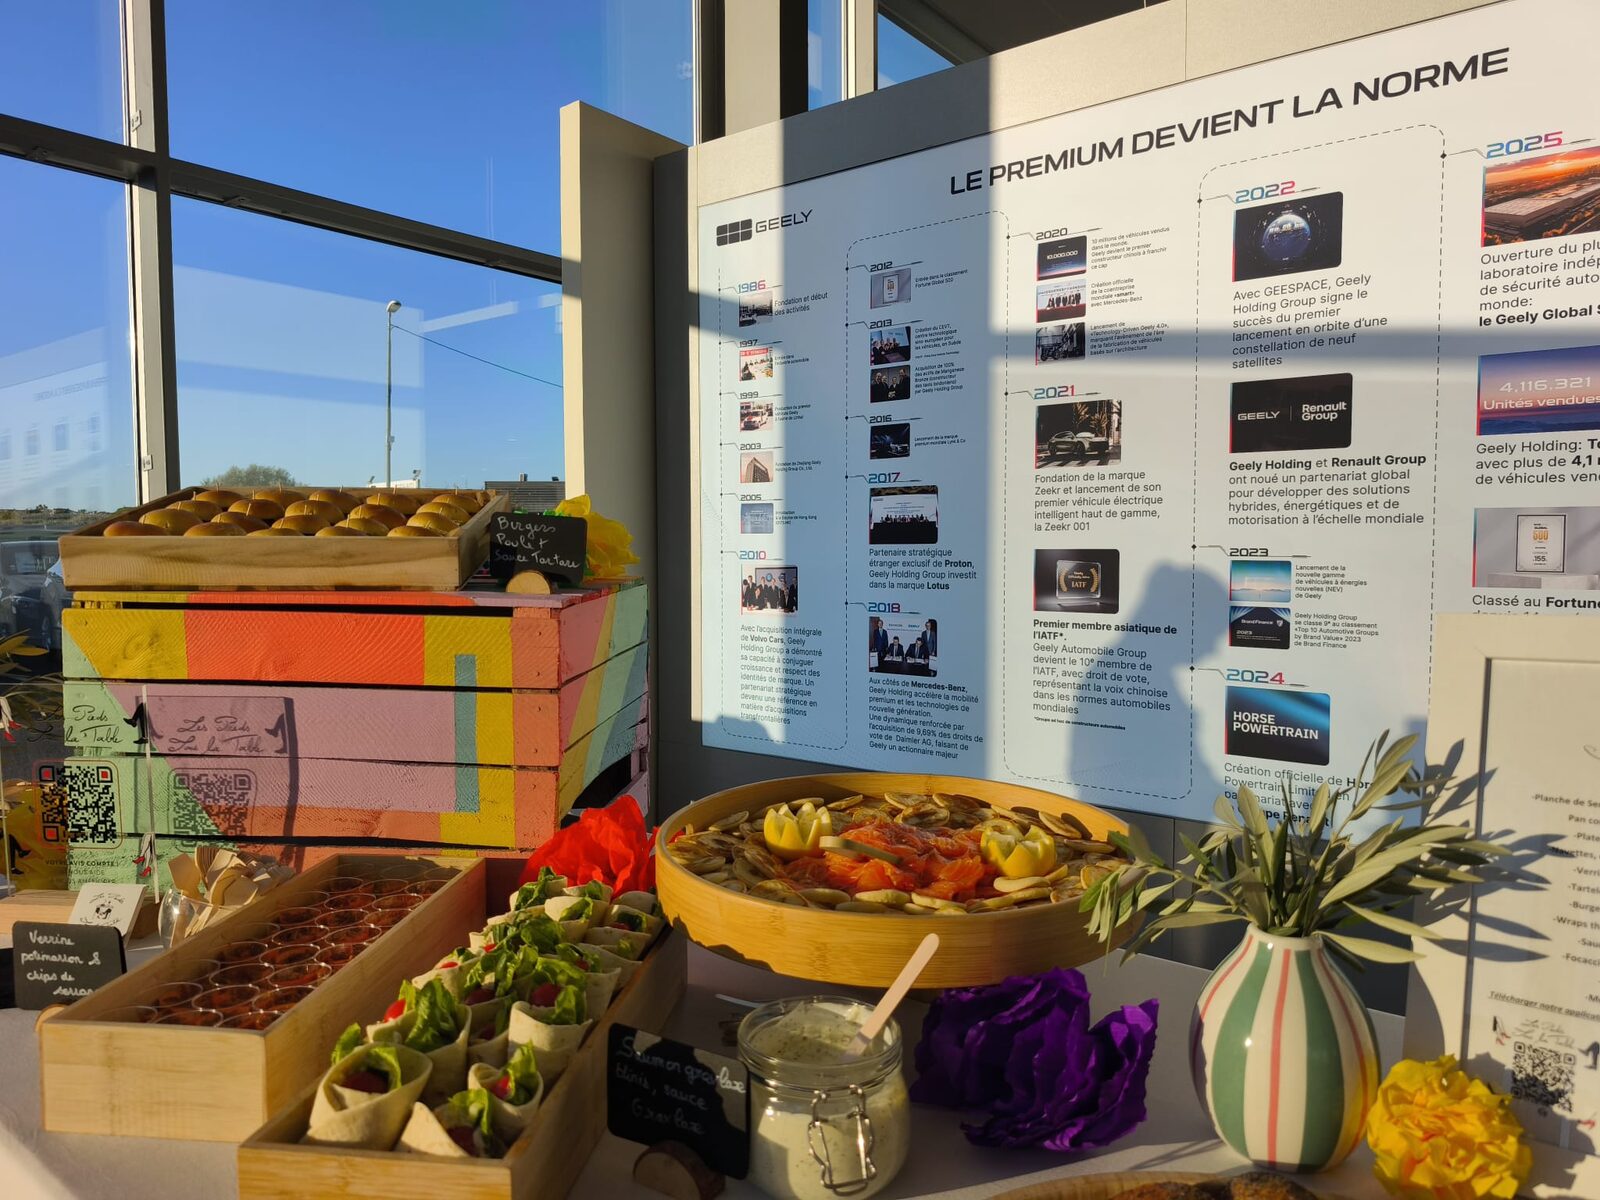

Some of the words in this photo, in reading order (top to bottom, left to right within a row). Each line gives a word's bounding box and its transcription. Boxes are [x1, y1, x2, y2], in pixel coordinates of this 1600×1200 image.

[951, 169, 983, 195] LE
[989, 137, 1125, 187] PREMIUM
[1131, 99, 1283, 156] DEVIENT
[1292, 87, 1344, 119] LA
[1353, 48, 1510, 106] NORME
[1486, 131, 1563, 159] 2025
[1236, 181, 1295, 203] 2022
[755, 209, 813, 233] GEELY
[1036, 227, 1068, 240] 2020
[1481, 247, 1554, 265] Ouverture
[1558, 243, 1578, 255] du
[870, 261, 893, 272] 2012
[1480, 261, 1558, 281] laboratoire
[738, 280, 766, 293] 1986
[1233, 288, 1260, 301] Avec
[1264, 279, 1331, 297] GEESPACE,
[1335, 273, 1371, 288] Geely
[1480, 284, 1498, 296] de
[1502, 276, 1561, 294] sécurité
[775, 298, 802, 307] Fondation
[811, 292, 828, 301] début
[1233, 302, 1276, 315] Holding
[1280, 297, 1316, 309] Group
[1320, 291, 1353, 304] signe
[1357, 289, 1368, 299] le
[1480, 297, 1533, 312] monde:
[786, 305, 810, 314] activités
[1479, 316, 1492, 327] le
[1496, 311, 1538, 325] Geely
[1543, 305, 1593, 321] Global
[870, 319, 892, 329] 2013
[1233, 315, 1272, 328] succès
[1276, 312, 1291, 323] du
[1294, 307, 1341, 323] premier
[740, 339, 758, 347] 1997
[1499, 376, 1591, 393] 4.116.321
[740, 391, 759, 399] 1999
[1034, 385, 1075, 399] 2021
[1302, 402, 1347, 413] Renault
[1484, 399, 1533, 410] Unités
[869, 415, 892, 423] 2016
[1237, 411, 1280, 420] GEELY
[1302, 412, 1338, 421] Group
[1476, 442, 1517, 455] Geely
[1521, 441, 1582, 452] Holding:
[1229, 461, 1262, 472] Geely
[1265, 459, 1312, 470] Holding
[1315, 458, 1328, 467] et
[1332, 456, 1381, 467] Renault
[1384, 454, 1426, 466] Group
[1476, 459, 1509, 469] avec
[1514, 457, 1543, 471] plus
[1548, 456, 1566, 467] de
[1571, 455, 1592, 468] 4,1
[869, 472, 900, 483] 2017
[1035, 473, 1080, 483] Fondation
[1083, 472, 1095, 482] de
[1097, 472, 1105, 480] la
[1108, 471, 1146, 482] marque
[1476, 474, 1493, 485] de
[1498, 473, 1565, 484] véhicules
[1035, 486, 1060, 495] Zeekr
[1063, 486, 1072, 494] et
[1075, 484, 1124, 494] lancement
[1128, 483, 1140, 492] de
[1034, 498, 1068, 507] premier
[1072, 496, 1110, 506] véhicule
[1114, 496, 1163, 506] électrique
[1228, 501, 1280, 513] hybrides,
[1284, 499, 1363, 512] énergétiques
[1367, 499, 1378, 509] et
[1383, 499, 1400, 509] de
[1228, 514, 1299, 525] motorisation
[1302, 514, 1309, 524] à
[1365, 513, 1424, 523] mondiale
[497, 516, 556, 539] Burgers
[1034, 522, 1042, 531] la
[1044, 522, 1071, 531] Zeekr
[1073, 522, 1090, 531] 001
[740, 551, 766, 560] 2010
[869, 549, 906, 557] Partenaire
[908, 549, 952, 558] stratégique
[1229, 548, 1269, 556] 2023
[869, 559, 900, 568] étranger
[902, 560, 931, 568] exclusif
[933, 560, 942, 568] de
[944, 559, 974, 568] Proton,
[1071, 580, 1087, 588] IATF
[1472, 594, 1519, 606] Classé
[1524, 598, 1541, 607] au
[868, 602, 901, 613] 2018
[1033, 619, 1070, 630] Premier
[1072, 622, 1112, 631] membre
[1114, 624, 1161, 635] asiatique
[1164, 625, 1177, 634] de
[741, 634, 748, 642] de
[750, 635, 767, 643] Volvo
[769, 636, 785, 645] Cars,
[788, 637, 805, 646] Geely
[1033, 643, 1058, 653] Geely
[1061, 644, 1114, 656] Automobile
[1117, 648, 1147, 658] Group
[1226, 669, 1284, 684] 2024
[882, 677, 900, 687] côtés
[901, 679, 909, 687] de
[911, 681, 968, 693] Mercedes-Benz,
[1233, 711, 1275, 724] HORSE
[1233, 722, 1319, 739] POWERTRAIN
[1224, 763, 1271, 777] Création
[1274, 769, 1324, 784] officielle
[1327, 775, 1343, 786] de
[1569, 814, 1586, 822] Pan
[29, 930, 75, 945] Verrine
[27, 969, 57, 982] chips
[60, 971, 75, 981] de
[1540, 1000, 1563, 1013] notre
